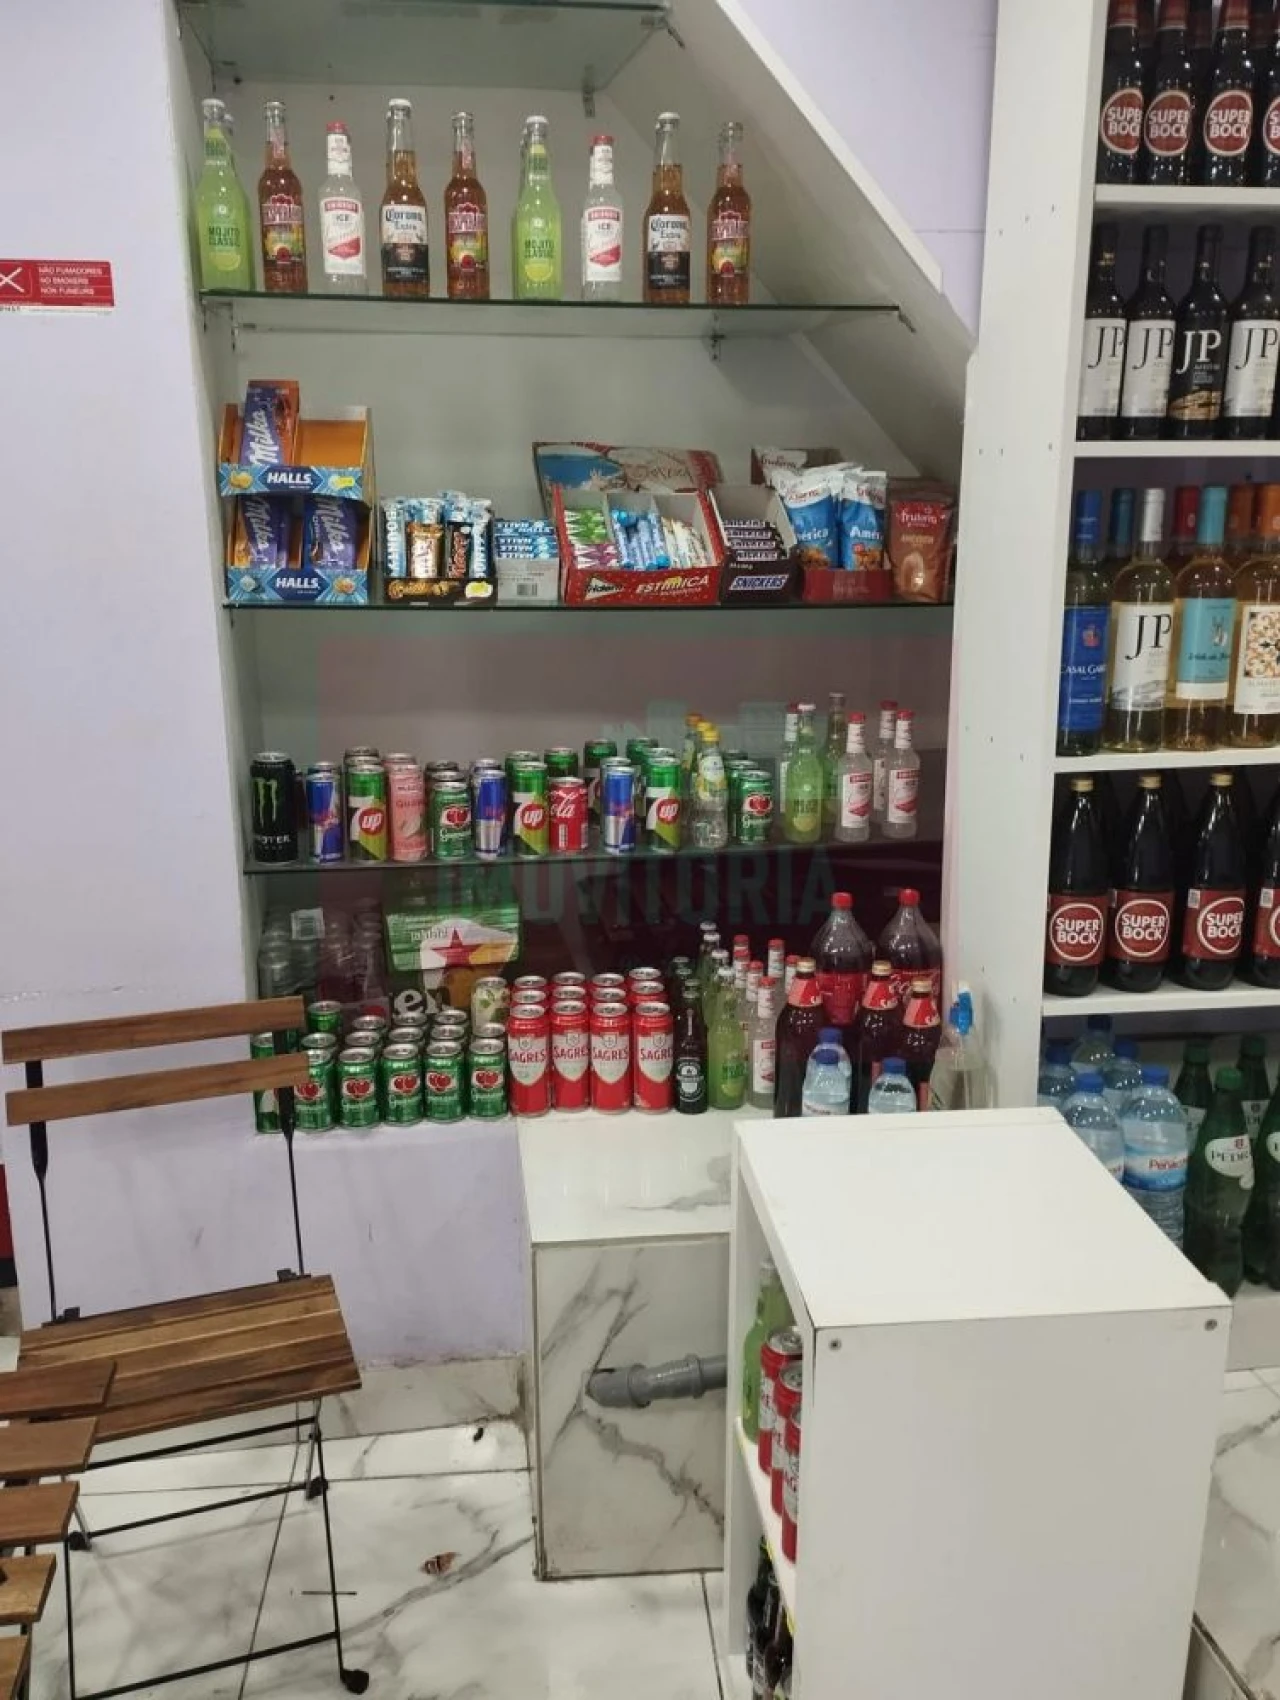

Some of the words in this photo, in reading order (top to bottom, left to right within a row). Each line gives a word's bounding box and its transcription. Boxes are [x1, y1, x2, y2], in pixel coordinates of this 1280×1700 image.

[1107, 106, 1142, 122] SUPE
[1108, 121, 1140, 136] BOC
[1175, 330, 1222, 375] JP
[1234, 328, 1278, 370] JP
[246, 408, 280, 465] Milka
[266, 472, 312, 484] HALLS
[276, 577, 319, 589] HALLS
[1125, 614, 1172, 661] JP
[1056, 917, 1100, 932] SUPER
[1121, 913, 1166, 928] SUPER
[1057, 930, 1097, 944] BOCK
[1122, 926, 1163, 941] BOCK
